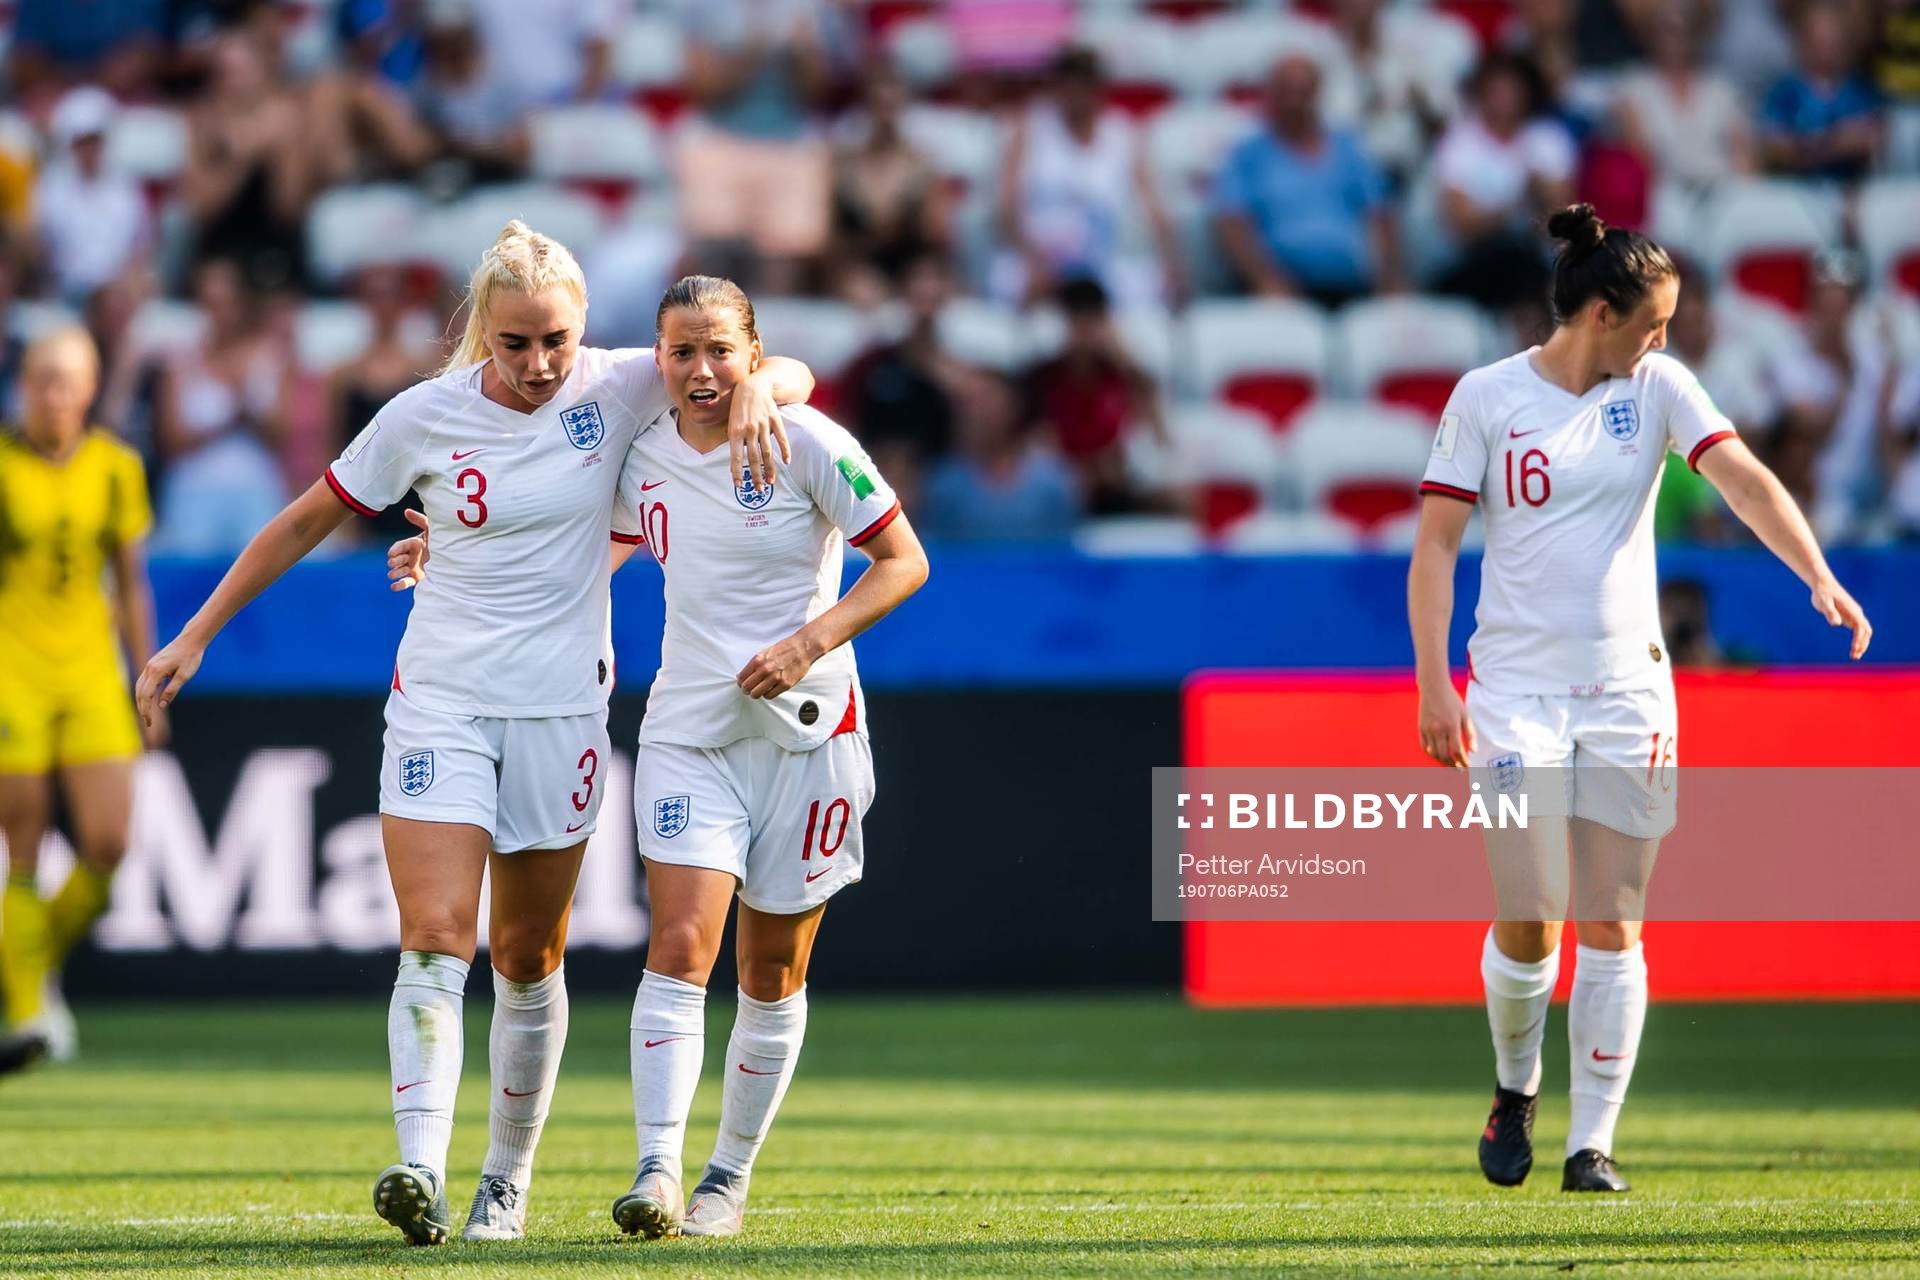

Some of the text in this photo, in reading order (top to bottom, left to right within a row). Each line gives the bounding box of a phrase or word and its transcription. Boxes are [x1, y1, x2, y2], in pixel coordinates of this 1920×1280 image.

[457, 468, 487, 528] 3
[1506, 449, 1551, 508] 16
[639, 501, 668, 565] 10
[572, 748, 598, 812] 3
[1647, 732, 1673, 793] 16
[801, 797, 851, 861] 10
